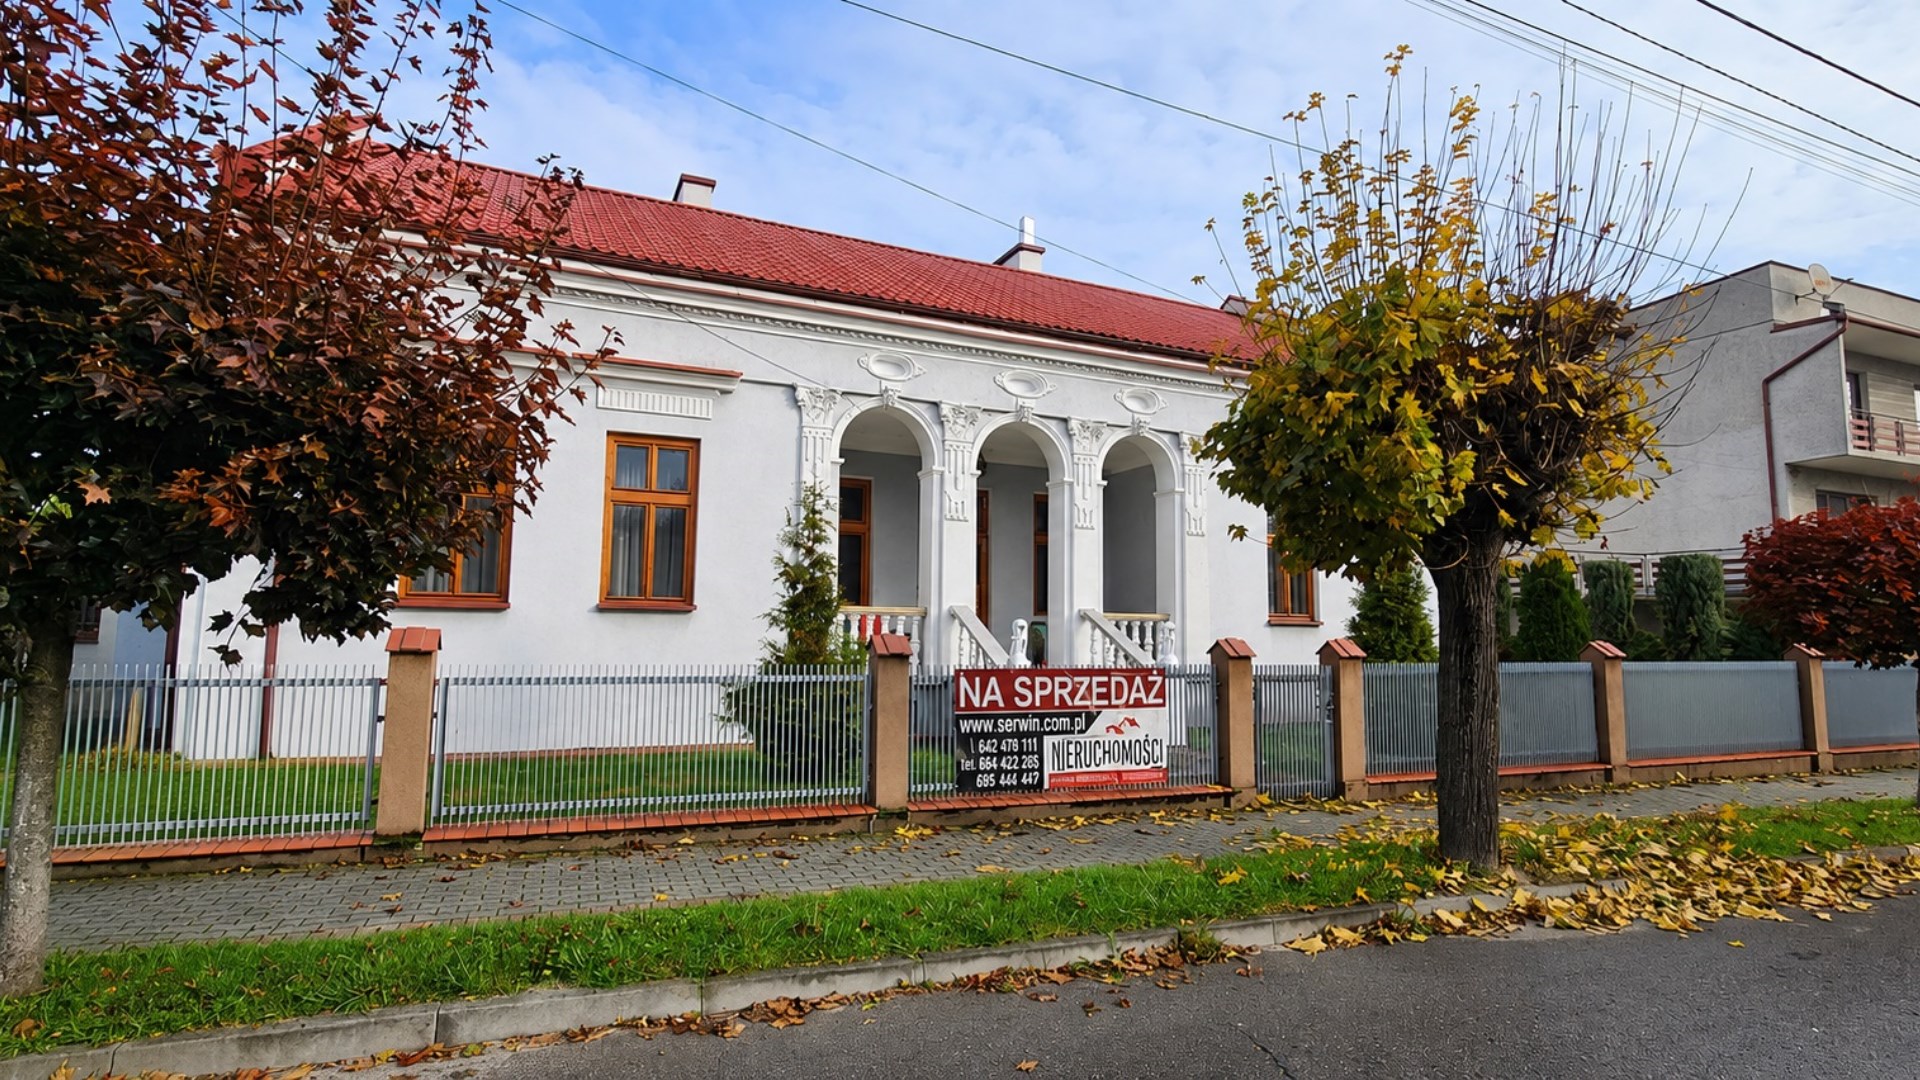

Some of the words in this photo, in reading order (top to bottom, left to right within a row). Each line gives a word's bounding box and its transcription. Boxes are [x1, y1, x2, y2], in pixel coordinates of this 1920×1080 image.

[959, 675, 1005, 708] NA
[1013, 669, 1164, 708] SPRZEDAŻ
[959, 712, 1086, 735] www.serwin.com.pl
[1052, 734, 1163, 771] NIERUCHOMOŚCI
